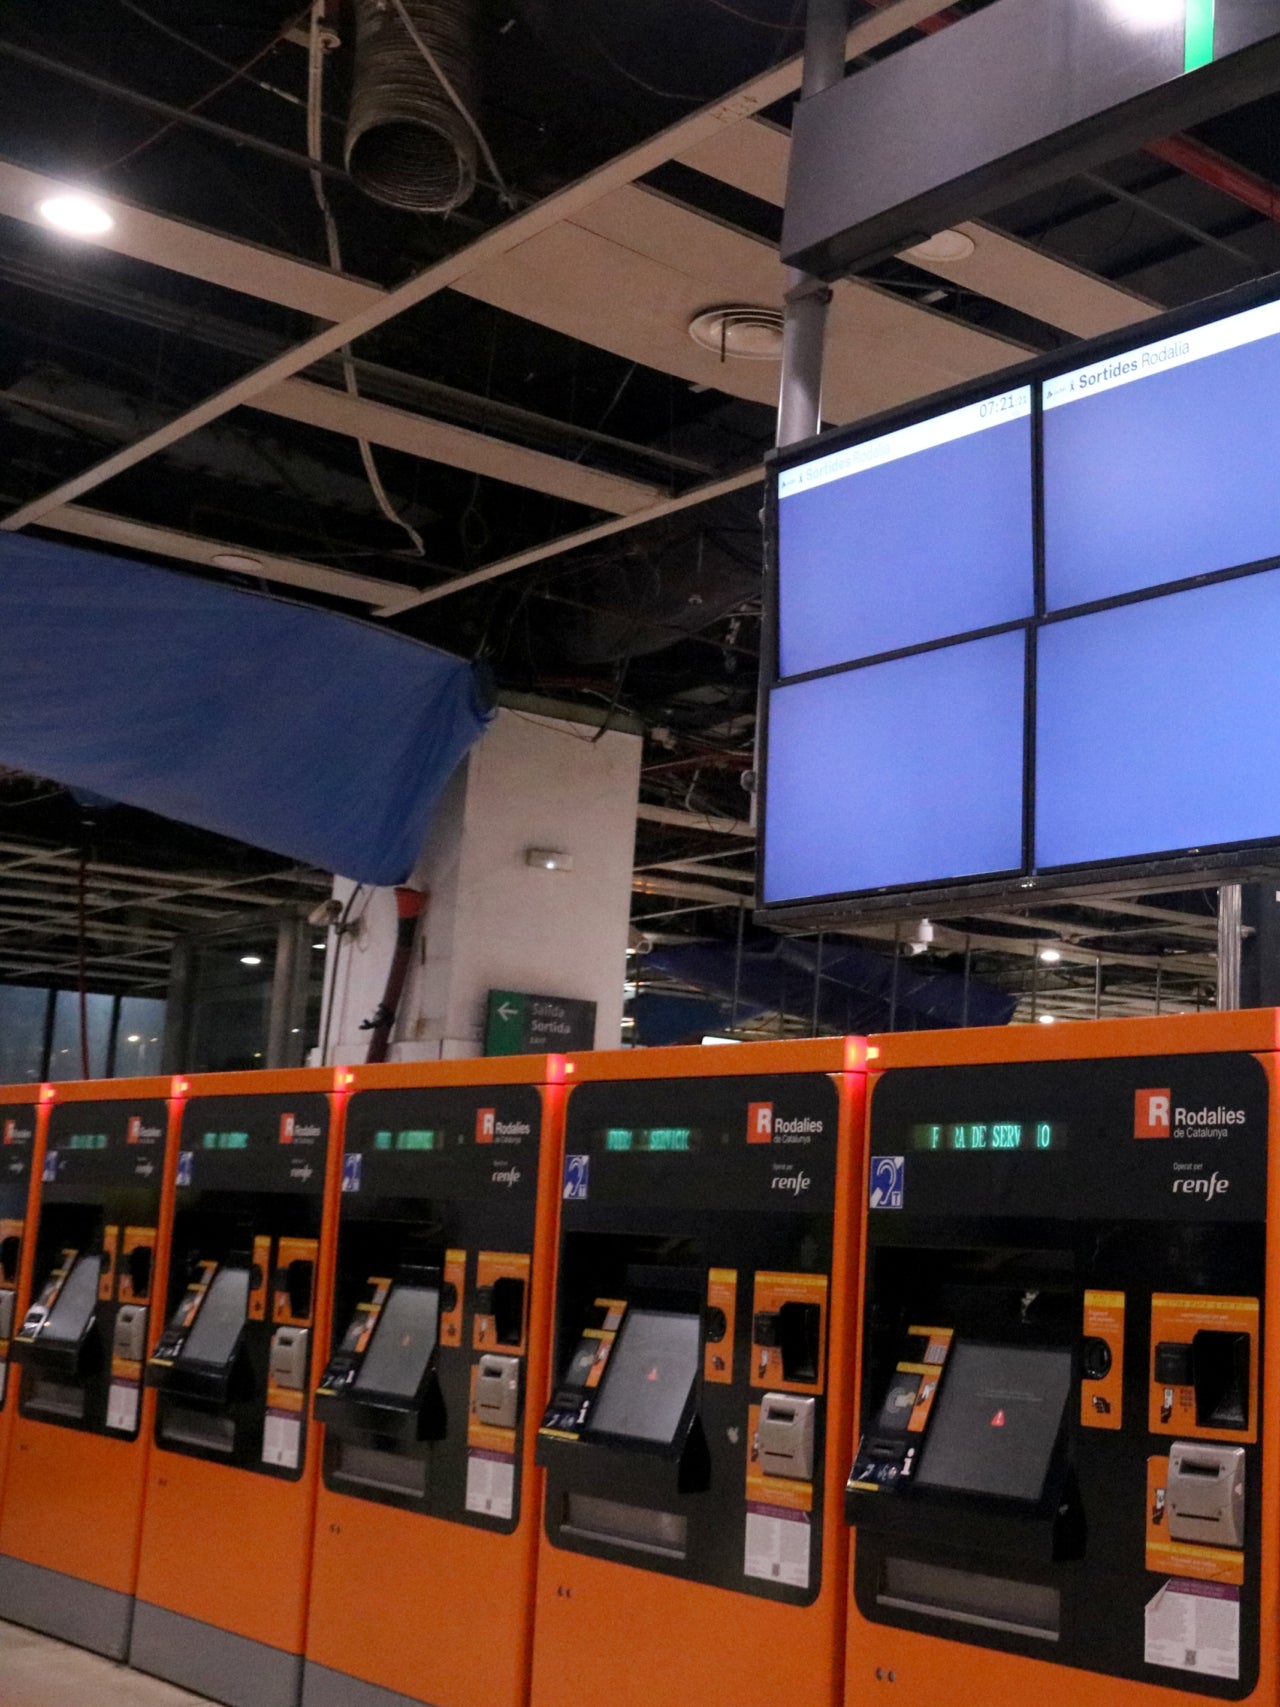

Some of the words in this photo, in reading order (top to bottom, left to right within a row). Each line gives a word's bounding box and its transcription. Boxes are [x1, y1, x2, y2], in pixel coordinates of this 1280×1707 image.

[1079, 360, 1138, 389] Sortides
[1141, 340, 1190, 368] Rodalia
[531, 1019, 571, 1034] Sortida
[774, 1116, 823, 1134] Rodalies
[1174, 1106, 1246, 1126] Rodalies
[1173, 1128, 1184, 1138] de
[1186, 1127, 1228, 1140] Catalunya
[771, 1171, 810, 1197] renfe
[1172, 1171, 1229, 1202] renfe
